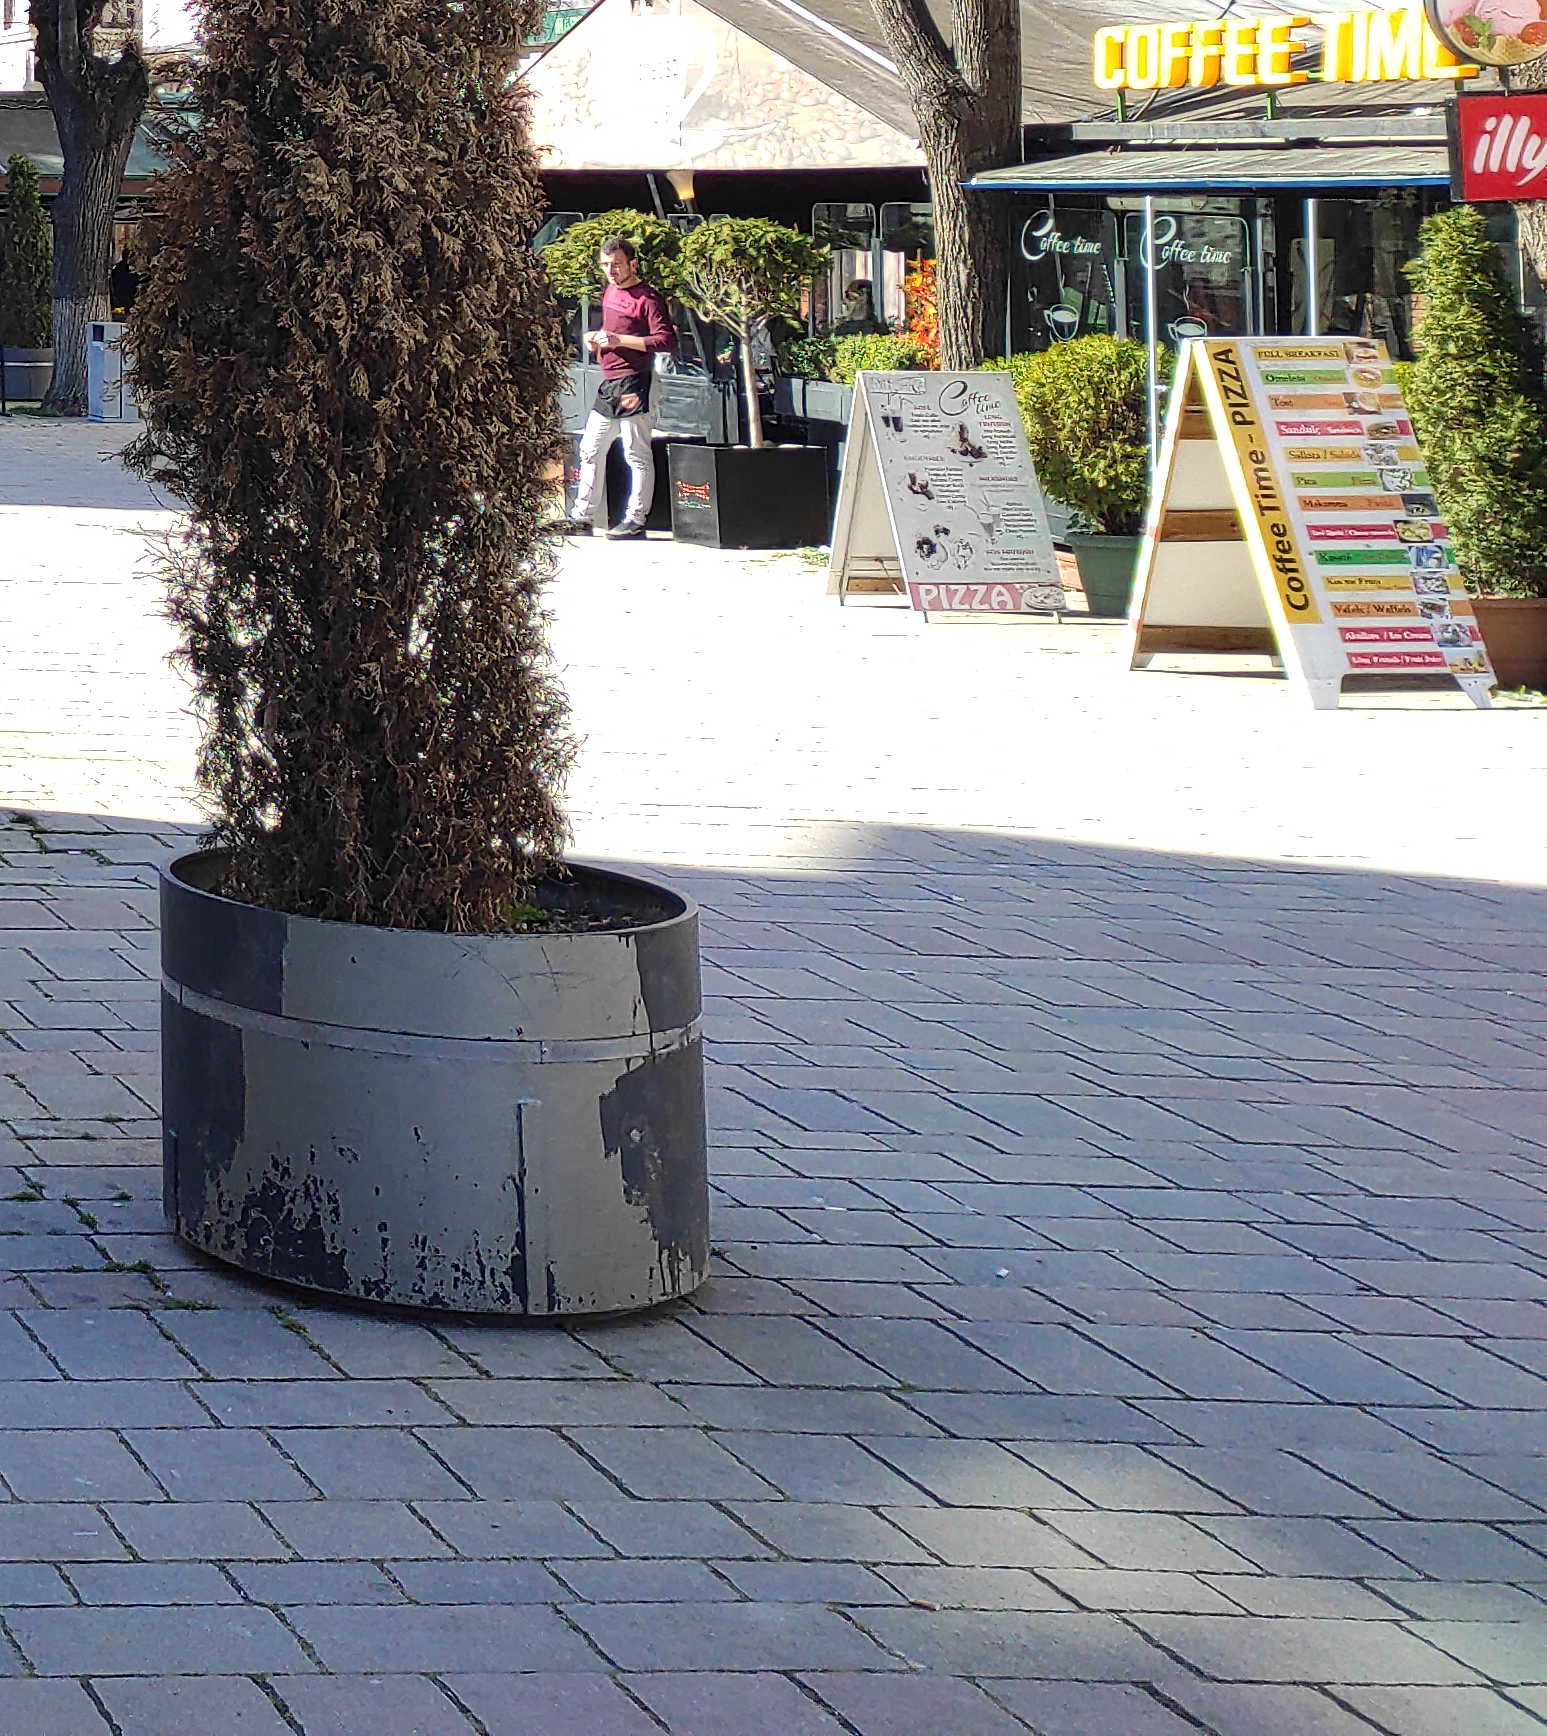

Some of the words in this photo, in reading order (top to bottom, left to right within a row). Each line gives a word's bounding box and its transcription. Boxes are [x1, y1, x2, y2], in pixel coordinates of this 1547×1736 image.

[1093, 16, 1311, 90] COFFEE
[1314, 8, 1479, 84] TIME
[1473, 114, 1547, 187] illy
[1021, 209, 1070, 261] Coffee
[1072, 235, 1102, 255] time
[1140, 216, 1195, 269] Coffee
[1200, 245, 1232, 264] time
[939, 380, 990, 416] Coffee
[1212, 348, 1257, 426] PIZZA
[1248, 448, 1282, 517] Time
[918, 584, 1014, 610] PIZZA
[1270, 522, 1310, 611] Coffee
